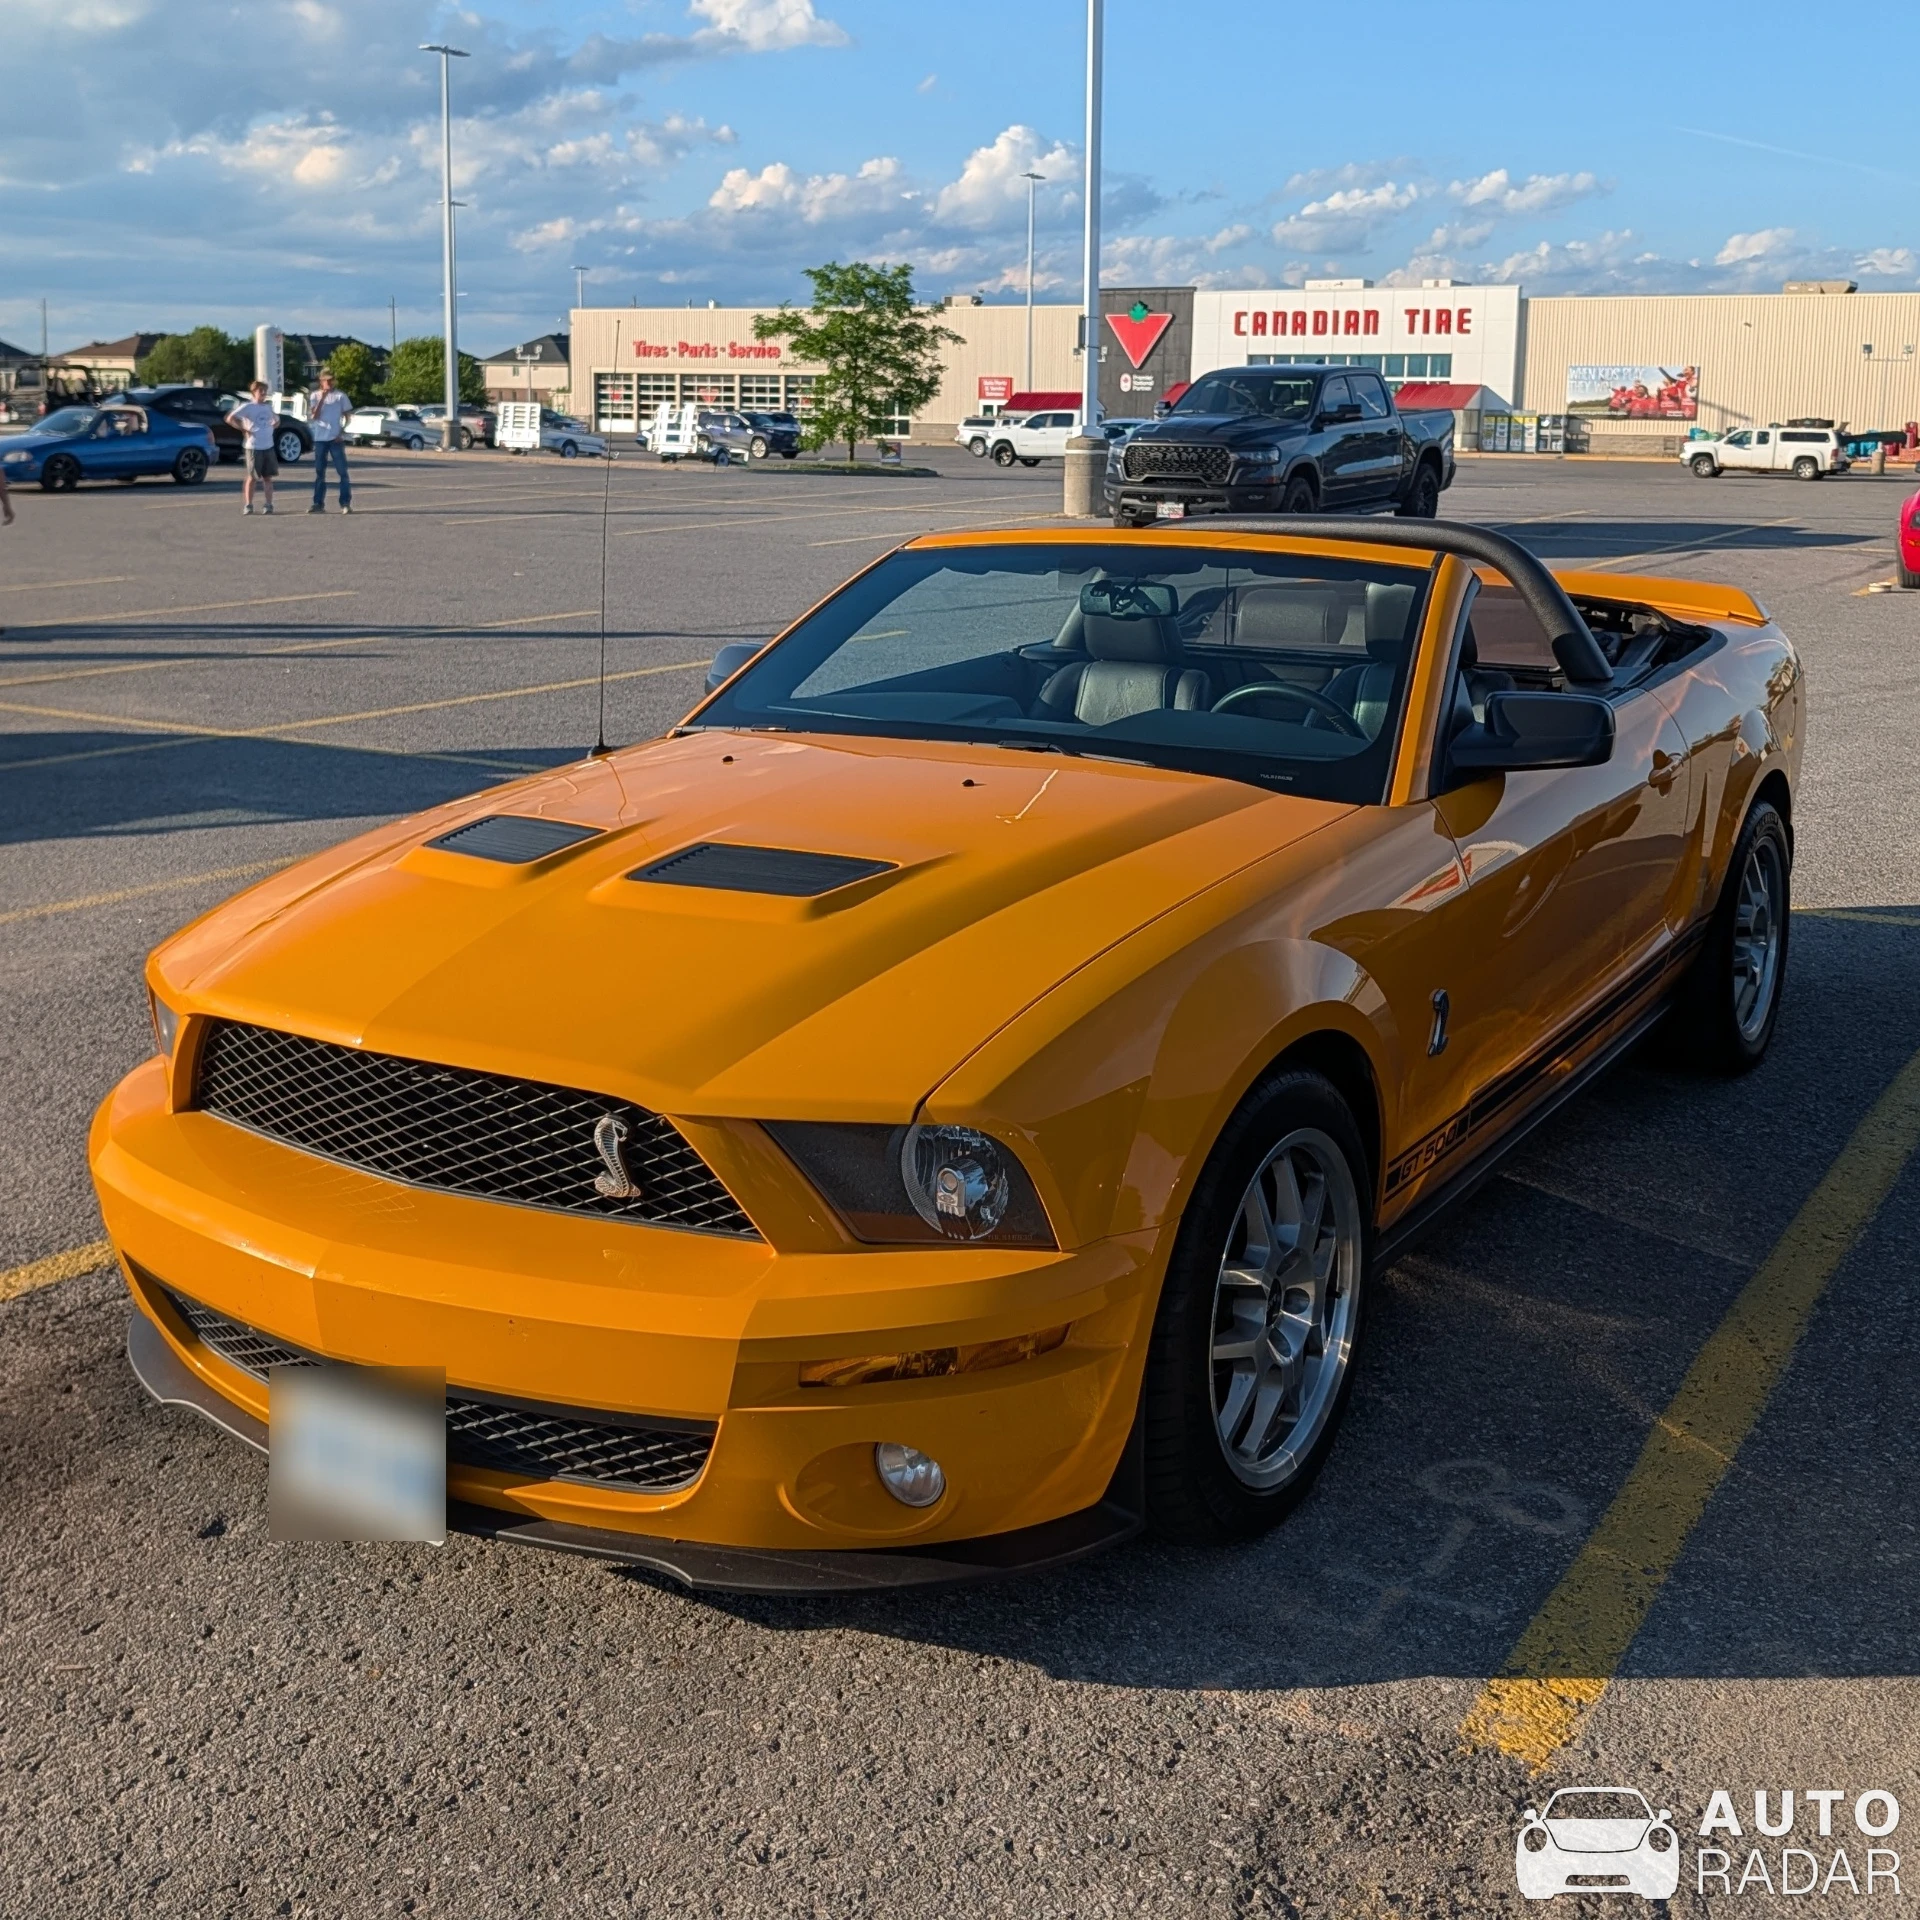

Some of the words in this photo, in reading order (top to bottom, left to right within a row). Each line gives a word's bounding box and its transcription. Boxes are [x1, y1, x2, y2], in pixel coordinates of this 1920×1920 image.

[1234, 309, 1379, 336] CANADIAN
[1404, 308, 1472, 335] TIRE
[633, 340, 669, 358] Tires
[678, 341, 718, 358] Parts
[728, 340, 781, 359] Service
[1599, 367, 1619, 380] KIDS
[1150, 452, 1199, 461] RAM
[1401, 1149, 1423, 1181] GT
[1423, 1122, 1458, 1164] 500
